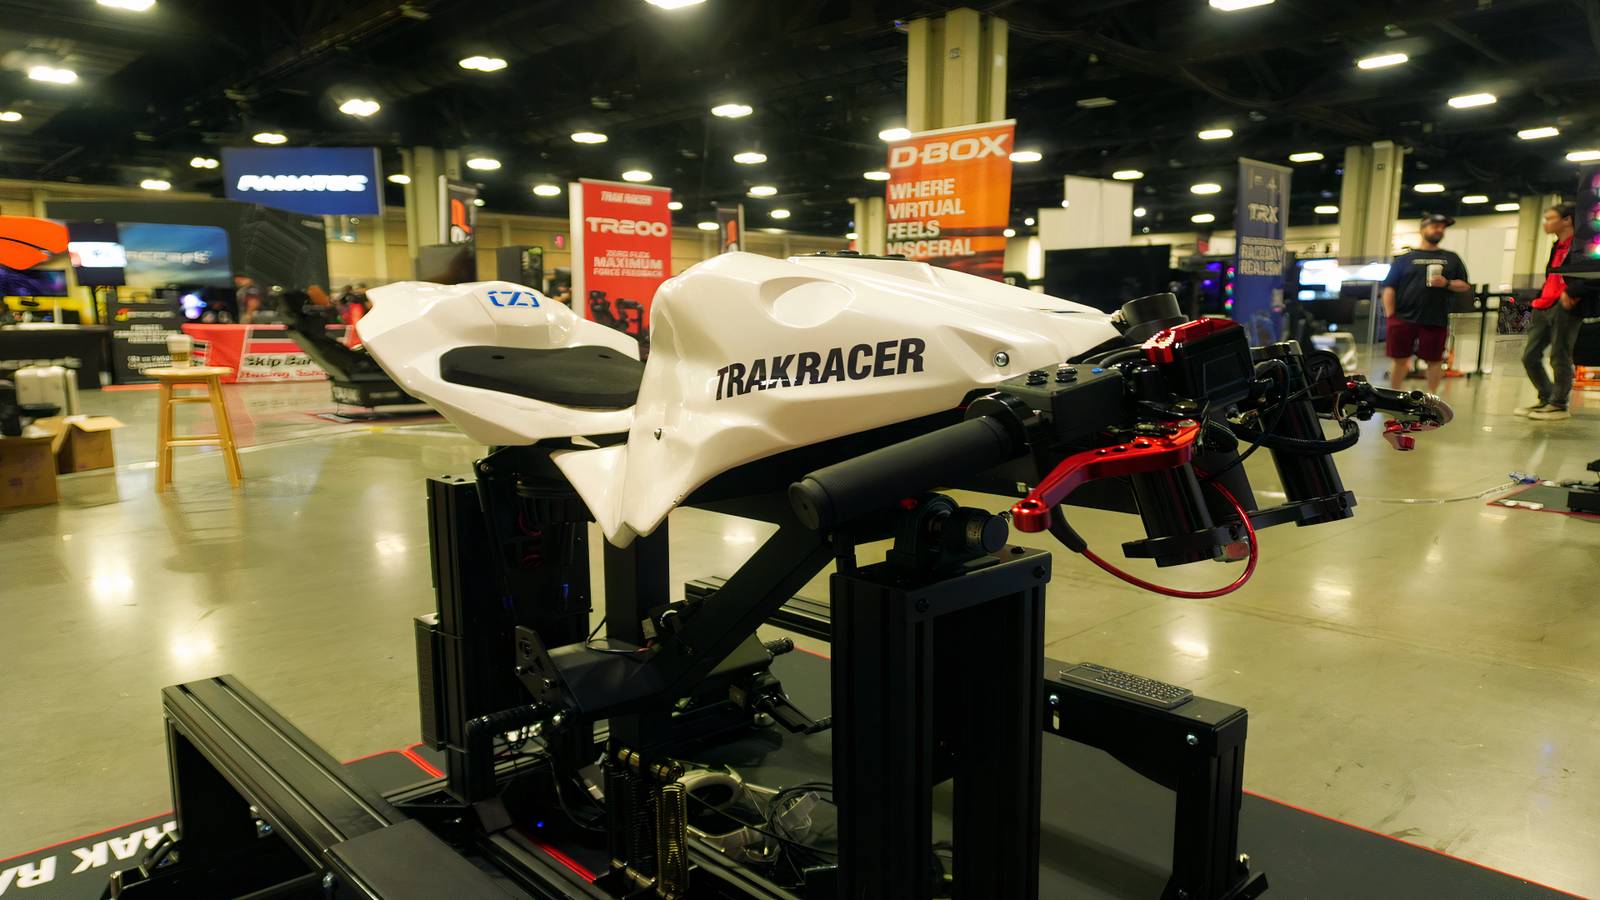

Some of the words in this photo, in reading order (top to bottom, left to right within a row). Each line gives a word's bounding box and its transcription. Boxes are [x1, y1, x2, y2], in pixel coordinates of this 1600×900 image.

[889, 133, 1009, 169] D-BOX
[889, 178, 956, 200] WHERE
[888, 198, 966, 220] VIRTUAL
[585, 216, 668, 238] TR200
[887, 220, 940, 240] FEELS
[886, 238, 976, 258] VISCERAL
[593, 256, 663, 270] MAXIMUM
